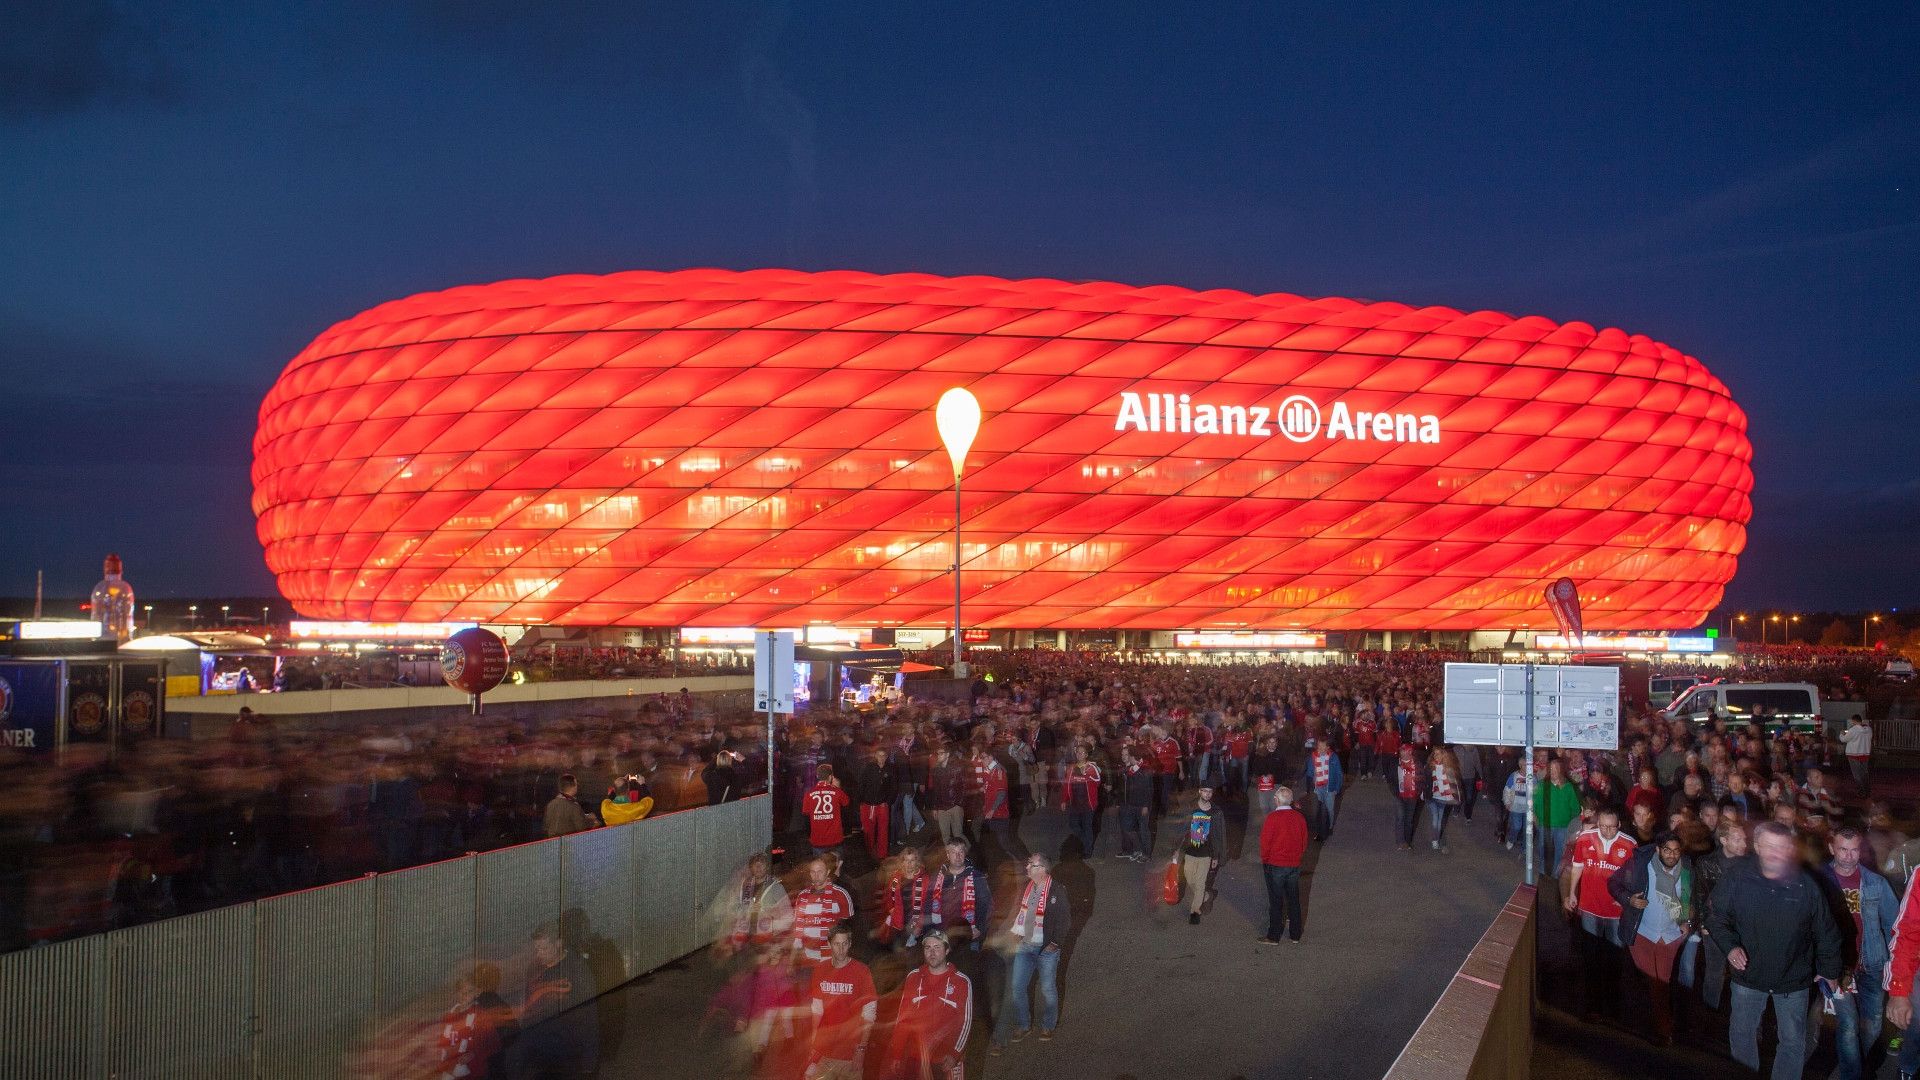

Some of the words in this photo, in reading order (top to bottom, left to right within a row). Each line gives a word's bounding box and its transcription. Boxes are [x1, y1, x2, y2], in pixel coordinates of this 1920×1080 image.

[1115, 392, 1270, 436] Allianz
[1327, 401, 1440, 443] Arena
[0, 728, 36, 747] NER
[812, 794, 833, 814] 28
